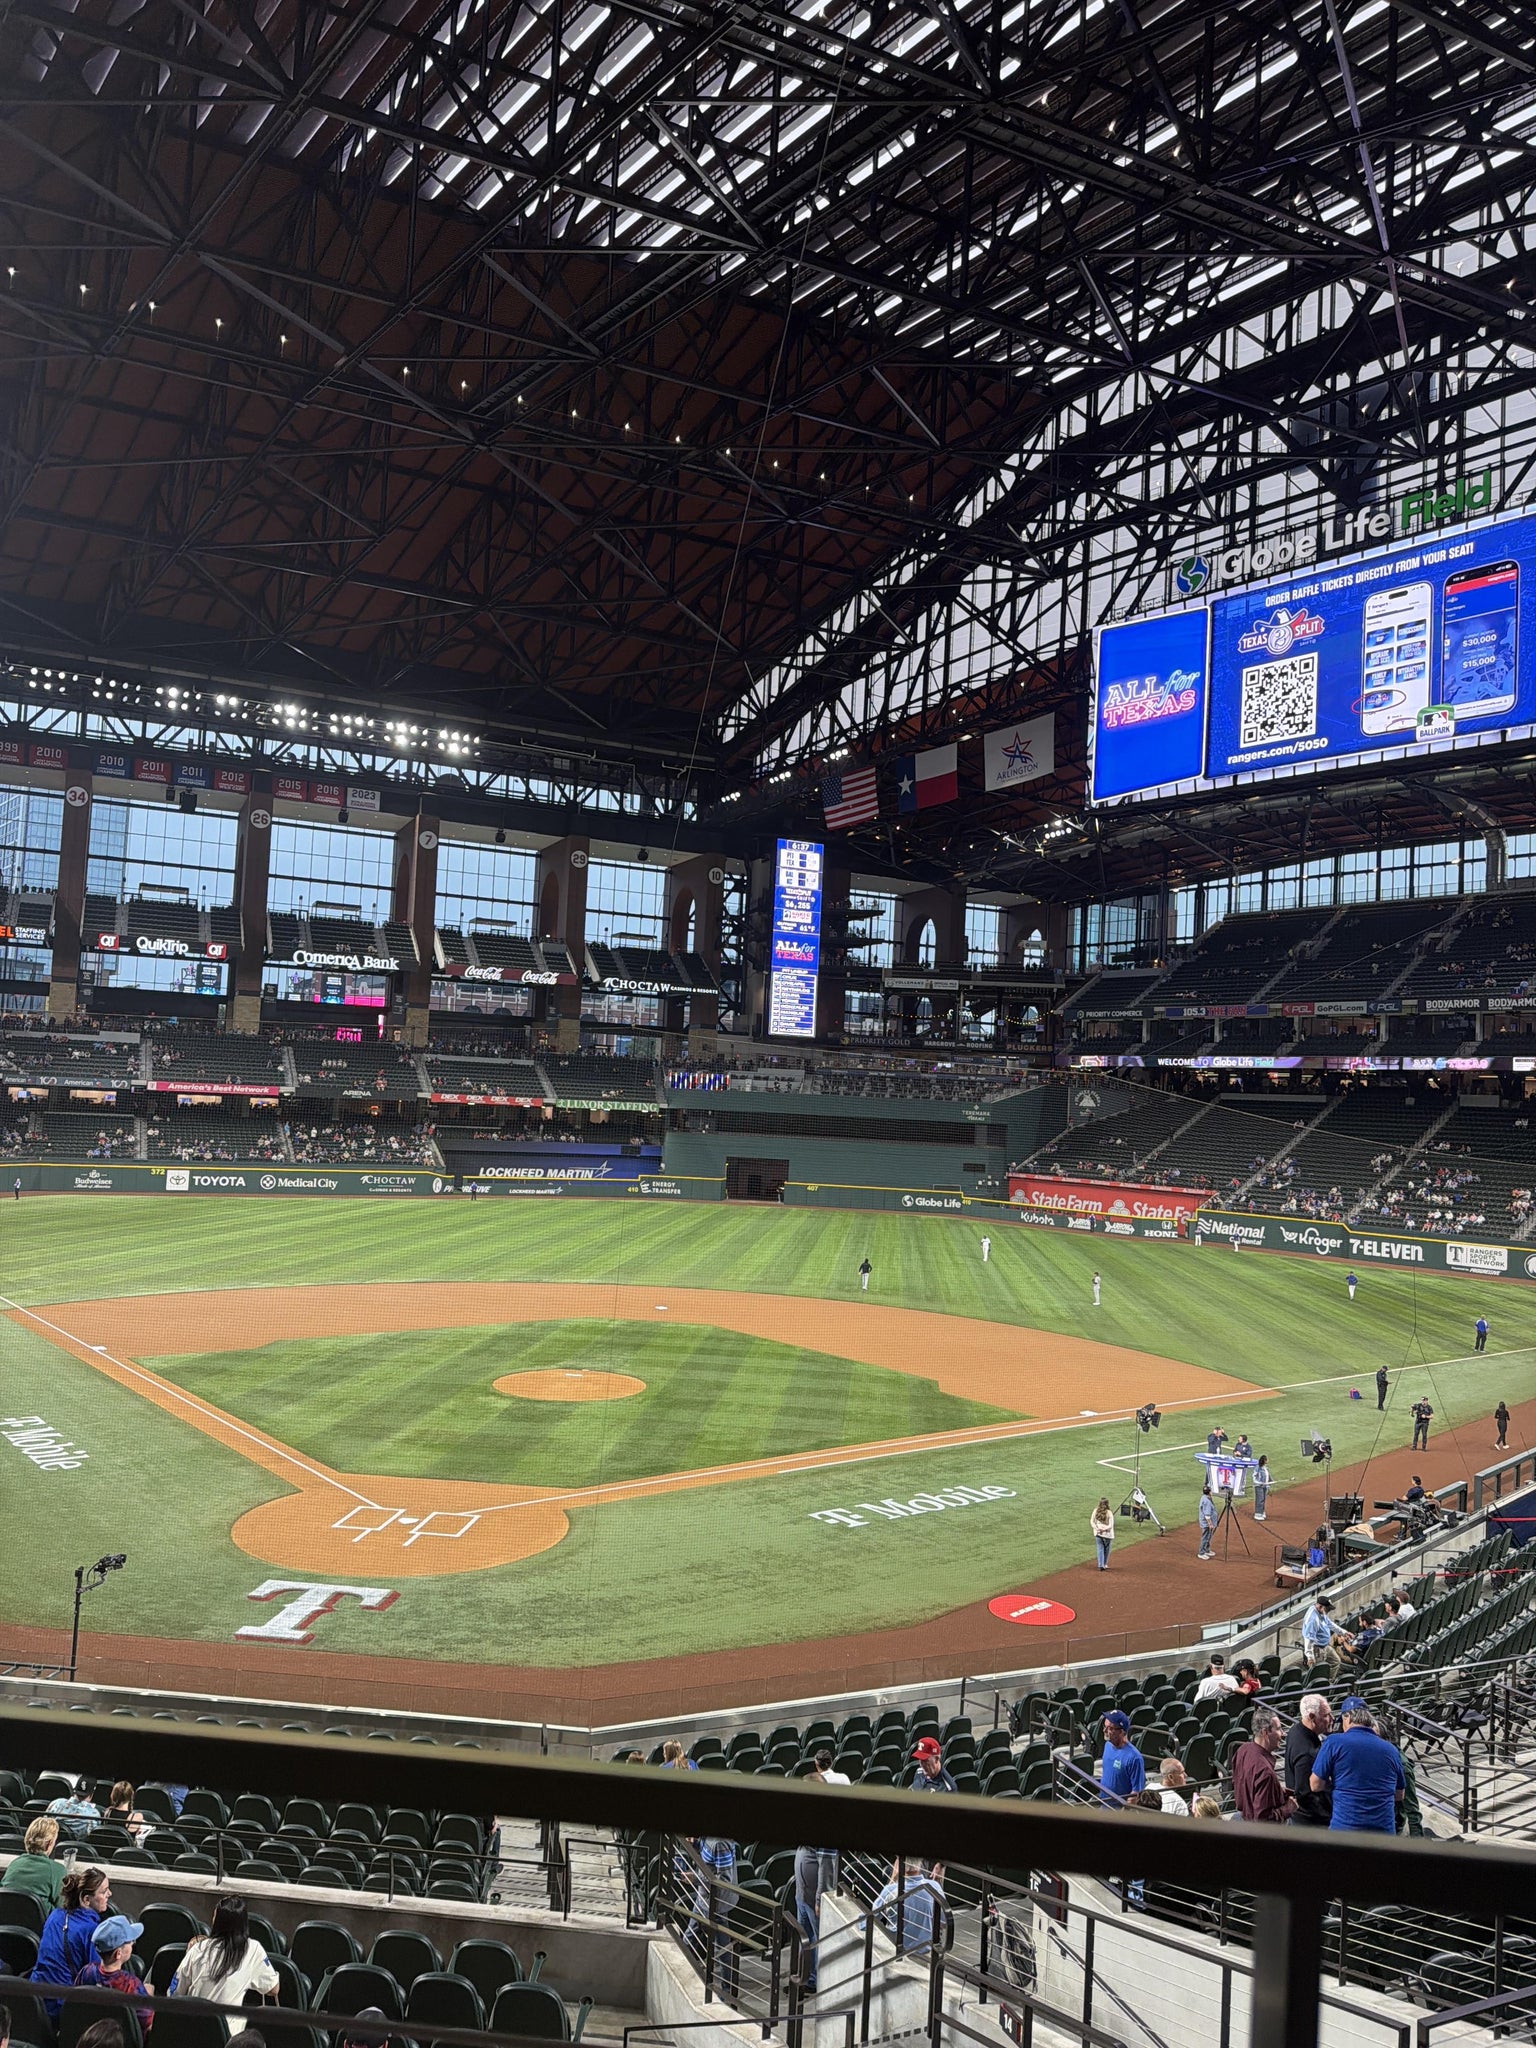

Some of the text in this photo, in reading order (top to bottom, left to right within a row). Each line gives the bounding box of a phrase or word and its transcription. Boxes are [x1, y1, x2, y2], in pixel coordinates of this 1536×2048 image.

[1218, 470, 1492, 580] Globe Life Field
[1265, 541, 1475, 608] ORDER RAFFLE TICKETS DIRECTLY FROM YOUR SEAT!
[1294, 620, 1320, 637] SPLIT
[1242, 633, 1268, 649] TEXAS
[1462, 633, 1497, 648] $30,000
[1462, 655, 1496, 670] $15,000
[1104, 669, 1200, 709] ALL for
[1104, 690, 1196, 729] TEXAS
[1420, 726, 1450, 737] BALLPARK
[36, 746, 62, 759] 2010
[1227, 737, 1328, 764] rangers.com/5050
[99, 754, 124, 767] 2010
[142, 760, 165, 772] 2011
[181, 765, 203, 777] 2011
[221, 770, 245, 783] 2012
[996, 762, 1039, 781] ARLINGTON
[278, 778, 301, 790] 2015
[316, 783, 339, 796] 2016
[69, 790, 86, 803] 34
[351, 788, 376, 801] 2023
[253, 813, 269, 826] 26
[424, 834, 433, 846] 7
[791, 843, 810, 851] 6:37
[572, 853, 586, 865] 29
[711, 869, 721, 882] 10
[15, 926, 46, 935] STAFFING
[15, 932, 45, 940] SERVICES
[100, 935, 117, 948] QT
[136, 936, 189, 954] QuikTrip
[208, 944, 225, 956] QT
[775, 940, 816, 957] ALL for
[775, 949, 814, 962] TEXAS
[363, 955, 400, 970] Bank
[608, 977, 671, 993] CHOCTAW
[1291, 1004, 1313, 1013] PGL
[1317, 1003, 1364, 1012] GoPGL.com
[1376, 1002, 1399, 1011] PGL
[1426, 999, 1480, 1009] BODYARMOR
[1086, 1009, 1143, 1018] PRIORITY COMMERCE
[1183, 1007, 1206, 1017] 105.3
[1207, 1006, 1226, 1016] THE
[850, 1037, 911, 1046] PRIORITY GOLD
[924, 1040, 993, 1049] HARGROVE ROOFING
[1157, 1056, 1275, 1067] WELCOME TO Globe Life Field
[167, 1082, 270, 1094] America's Best Network
[441, 1093, 459, 1101] DEX
[566, 1100, 659, 1112] LUXOR STAFFING
[363, 1175, 416, 1184] CHOCTAW
[479, 1167, 594, 1179] LOCKHEED MARTIN
[75, 1177, 113, 1185] Budweiser
[192, 1176, 246, 1187] TOYOTA
[278, 1177, 338, 1190] Medical City
[915, 1197, 962, 1209] Globe Life
[1031, 1190, 1103, 1213] State Farm
[1133, 1201, 1173, 1219] State
[1020, 1211, 1055, 1226] Kubota
[1210, 1220, 1265, 1239] National
[1241, 1237, 1262, 1246] Rental
[1298, 1227, 1343, 1255] Kroger
[1469, 1247, 1503, 1257] RANGERS
[1469, 1253, 1496, 1261] SPORTS
[1469, 1258, 1505, 1267] NETWORK
[0, 1426, 90, 1471] Mobile
[1217, 1467, 1234, 1485] T
[855, 1485, 1017, 1520] Mobile
[234, 1579, 401, 1645] T
[1004, 2013, 1012, 2034] 14
